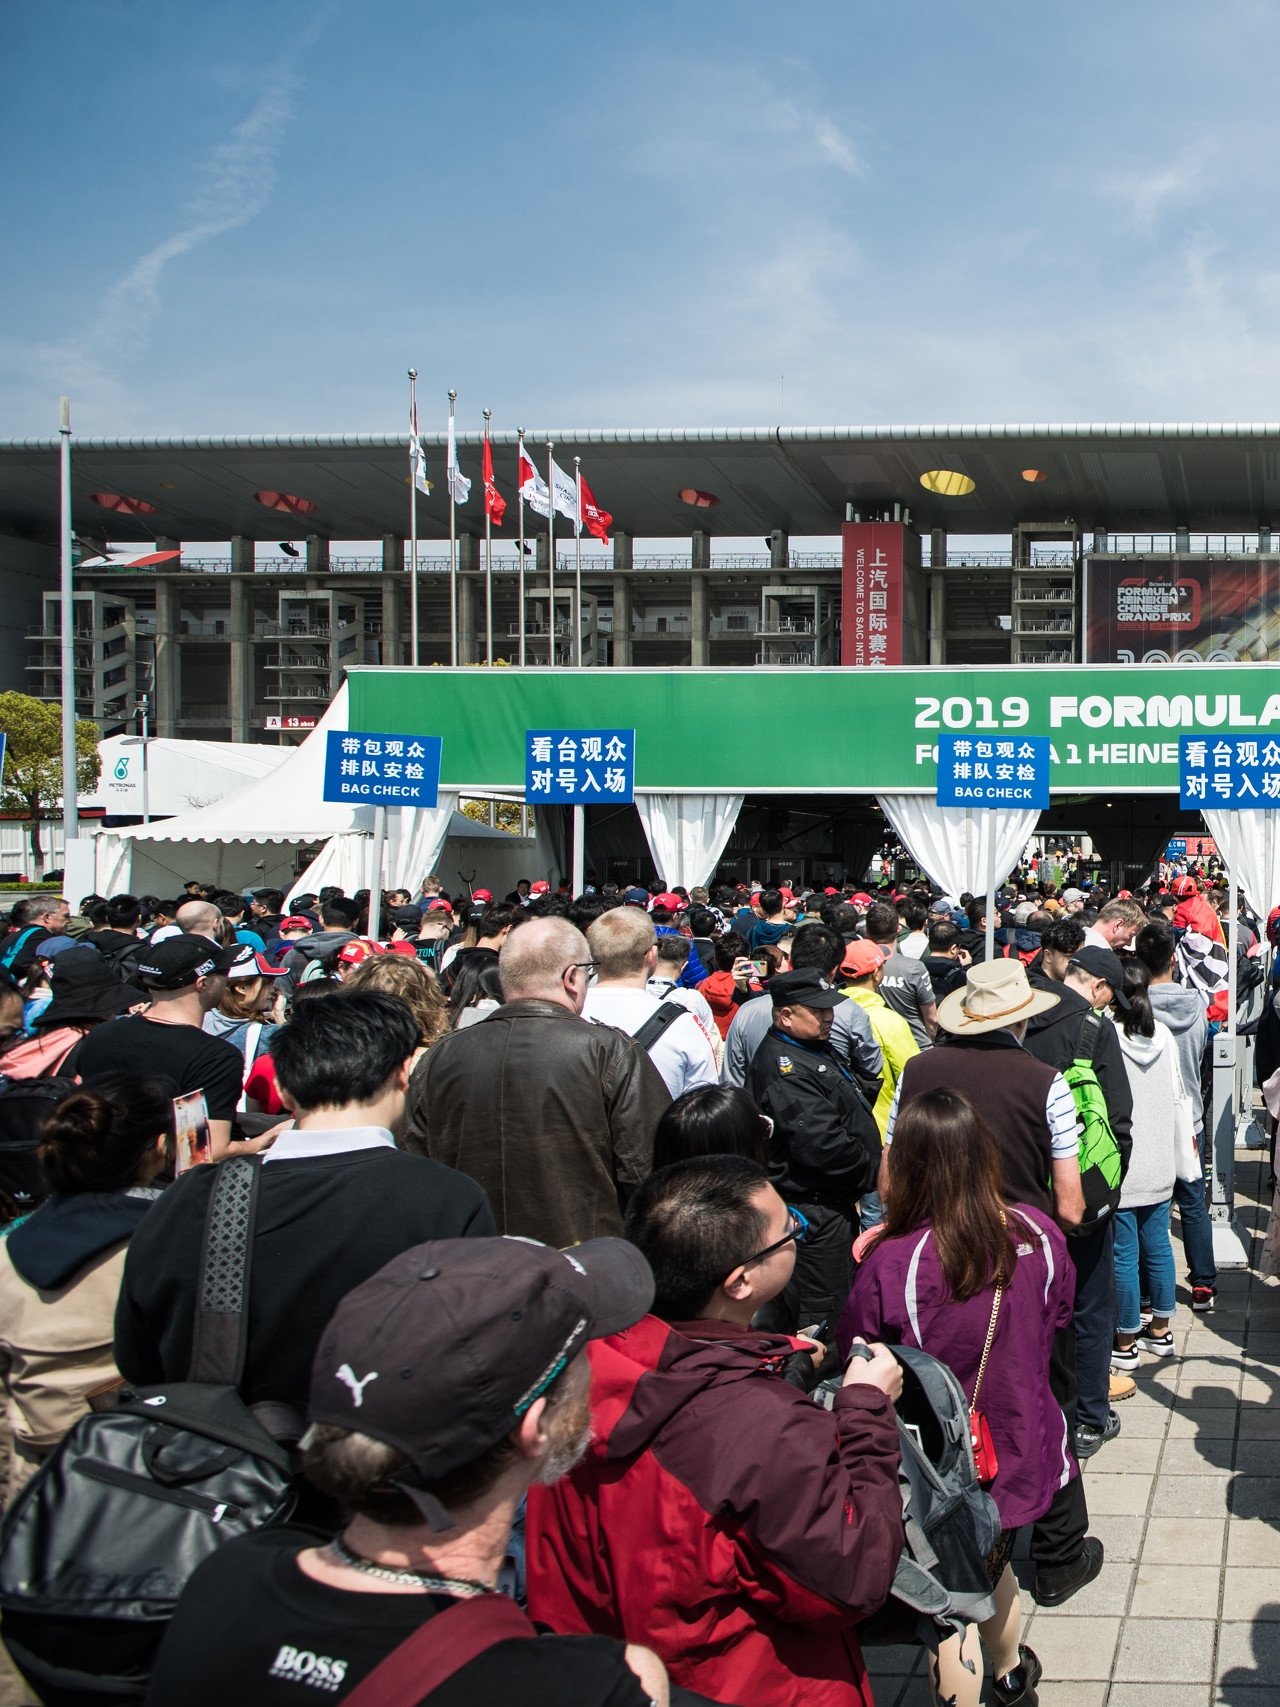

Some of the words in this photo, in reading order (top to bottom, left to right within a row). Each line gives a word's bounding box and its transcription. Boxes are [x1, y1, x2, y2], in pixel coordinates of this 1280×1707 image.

[856, 549, 864, 598] WELCOME
[1117, 587, 1178, 596] FORMULA
[1180, 588, 1187, 596] 1
[1117, 596, 1178, 604] HEINEKEN
[856, 601, 864, 614] TO
[1117, 604, 1168, 613] CHINESE
[1117, 613, 1160, 621] GRAND
[1162, 613, 1191, 622] PRIX
[856, 616, 864, 639] SAIC
[914, 696, 1030, 728] 2019
[288, 718, 299, 726] 13
[341, 738, 425, 758] 带包观众
[531, 736, 626, 763] 看台观众
[953, 741, 1035, 759] 带包观众
[1066, 743, 1082, 764] 1
[1089, 743, 1178, 764] HEINE
[341, 759, 425, 779] 排队安检
[953, 762, 1035, 781] 排队安检
[341, 783, 370, 795] BAG
[373, 785, 420, 797] CHECK
[531, 768, 626, 793] 对号入场
[955, 787, 983, 798] BAG
[987, 788, 1032, 798] CHECK
[274, 1645, 348, 1684] BOSS
